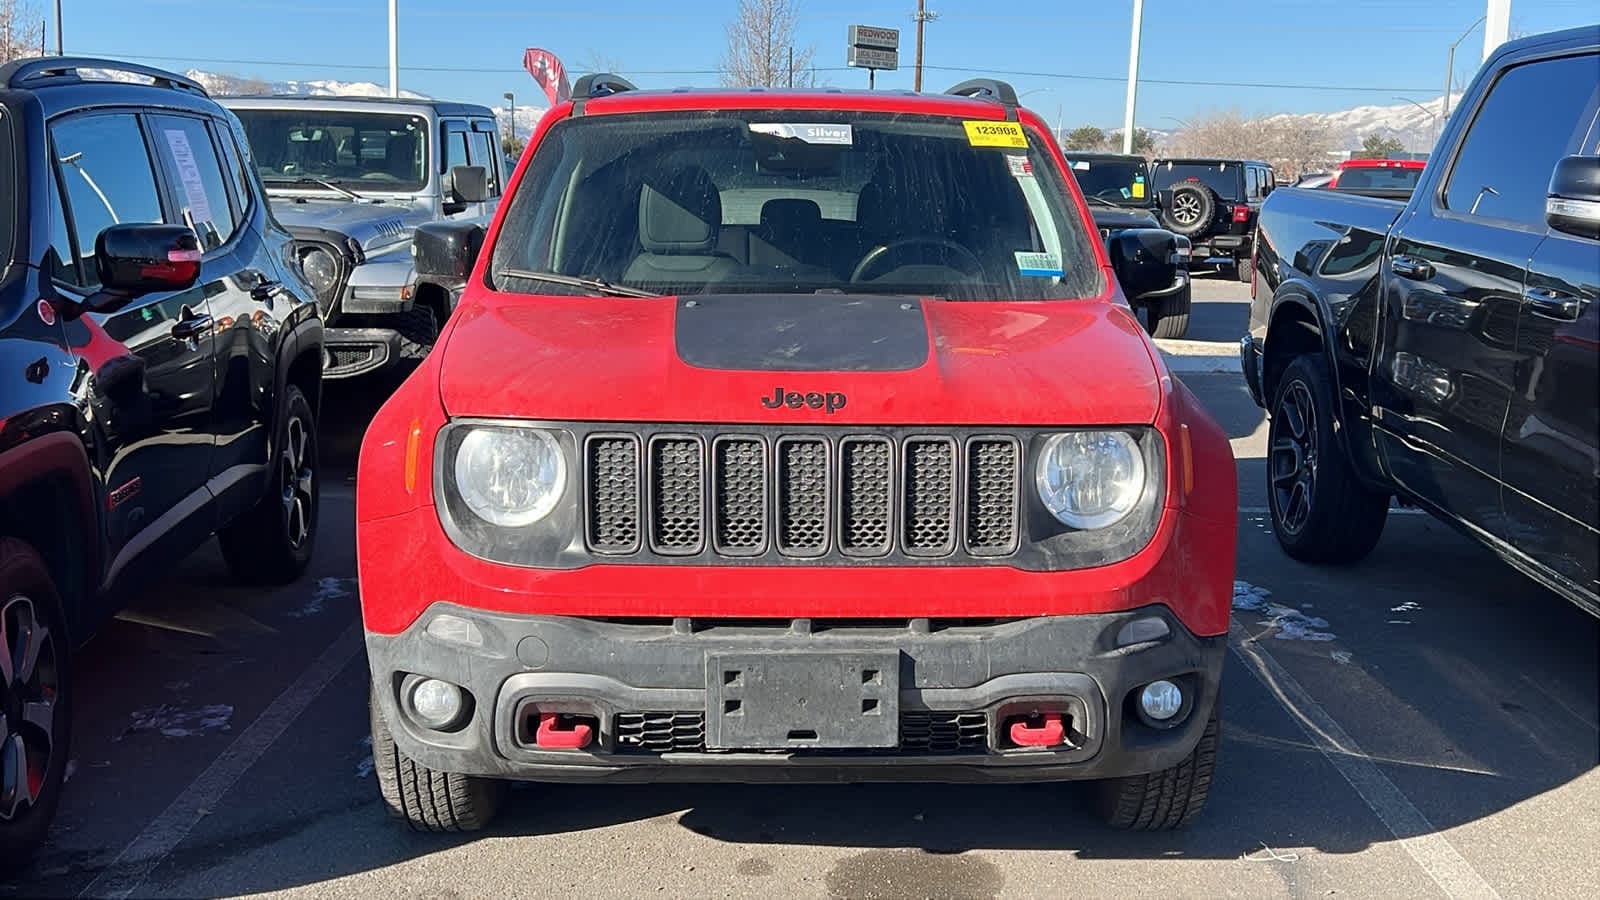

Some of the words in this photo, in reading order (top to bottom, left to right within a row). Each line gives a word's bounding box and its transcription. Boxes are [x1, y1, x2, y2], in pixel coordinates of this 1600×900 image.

[857, 29, 897, 40] REDWOOD
[807, 127, 848, 138] Silver
[975, 126, 1018, 136] 123908
[761, 387, 847, 414] Jeep
